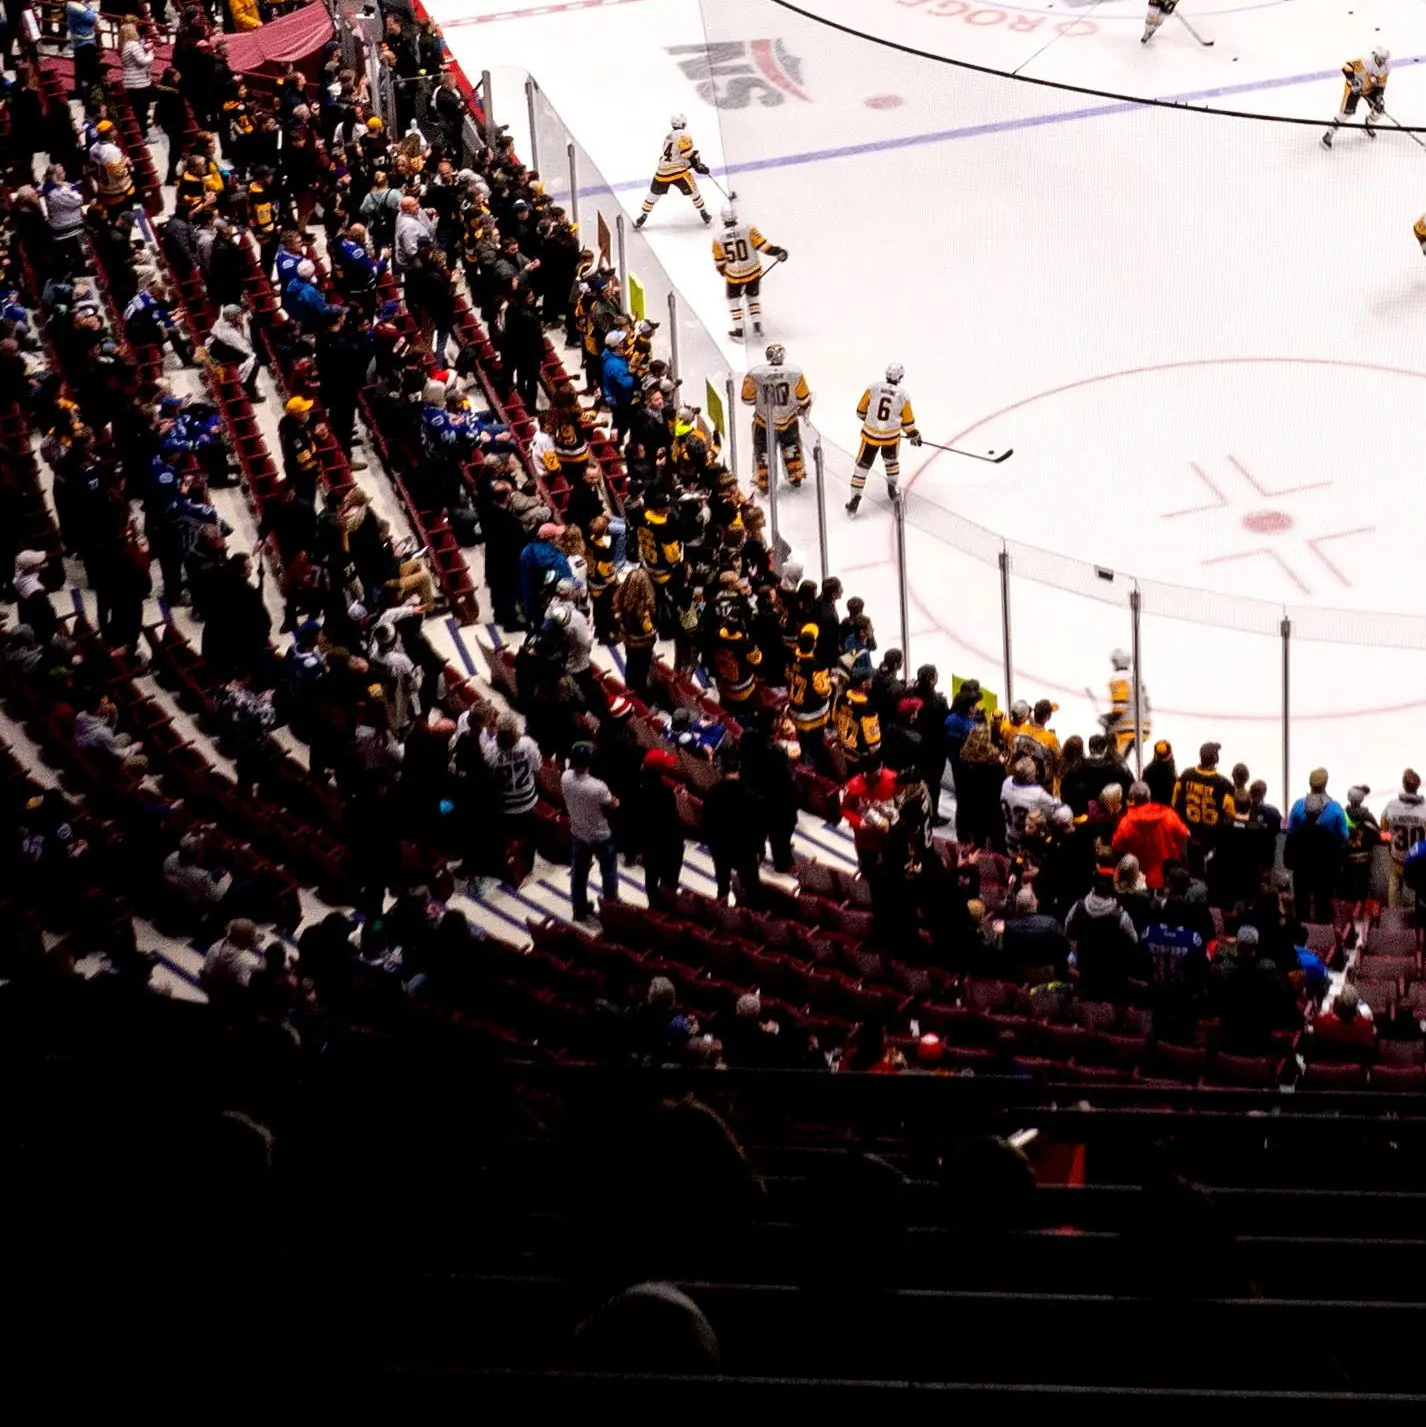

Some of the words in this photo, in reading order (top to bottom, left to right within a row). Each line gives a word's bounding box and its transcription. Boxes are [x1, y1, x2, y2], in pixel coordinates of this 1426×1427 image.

[723, 239, 749, 264] 50
[877, 397, 891, 421] 6
[1184, 793, 1219, 827] 66
